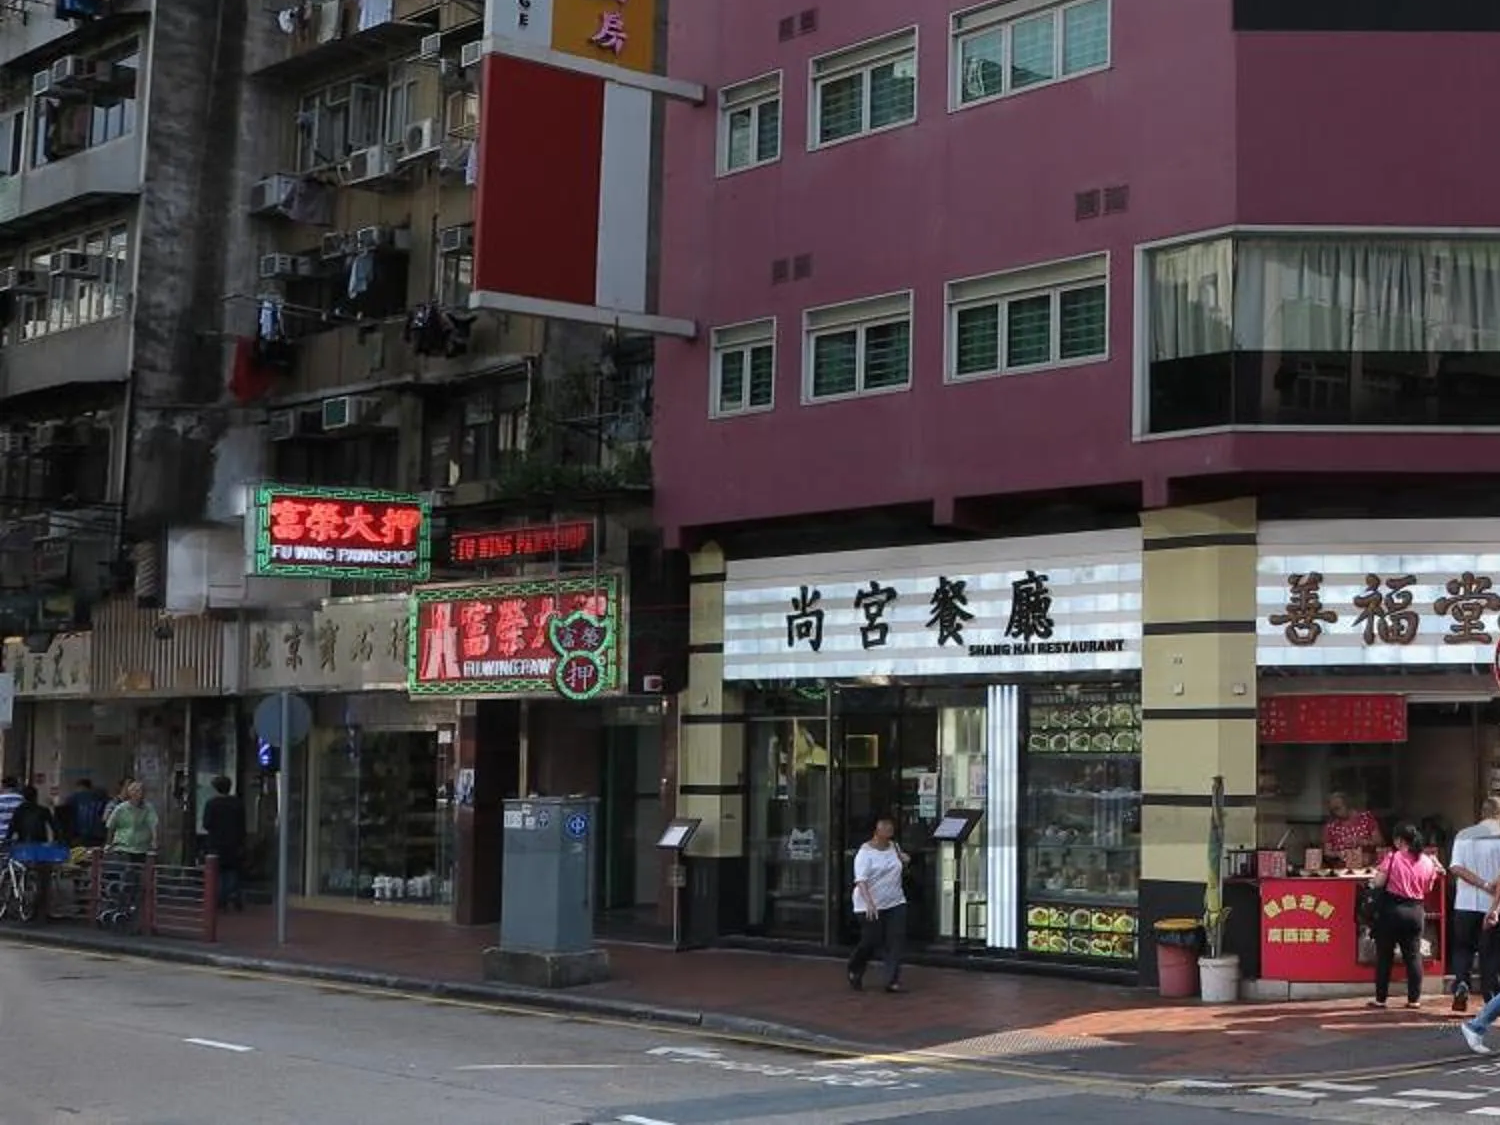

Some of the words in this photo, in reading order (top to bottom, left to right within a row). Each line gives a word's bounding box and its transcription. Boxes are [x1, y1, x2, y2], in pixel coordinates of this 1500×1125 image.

[271, 499, 423, 546] 富榮大押
[271, 545, 295, 560] FU
[296, 546, 334, 562] WING
[337, 548, 417, 567] PAWNSHOP
[786, 570, 1056, 653] 尚宮餐廳
[968, 643, 1011, 658] SHANG
[1012, 642, 1036, 657] HAI
[1037, 639, 1125, 656] RESTAURANT
[566, 662, 594, 691] 押
